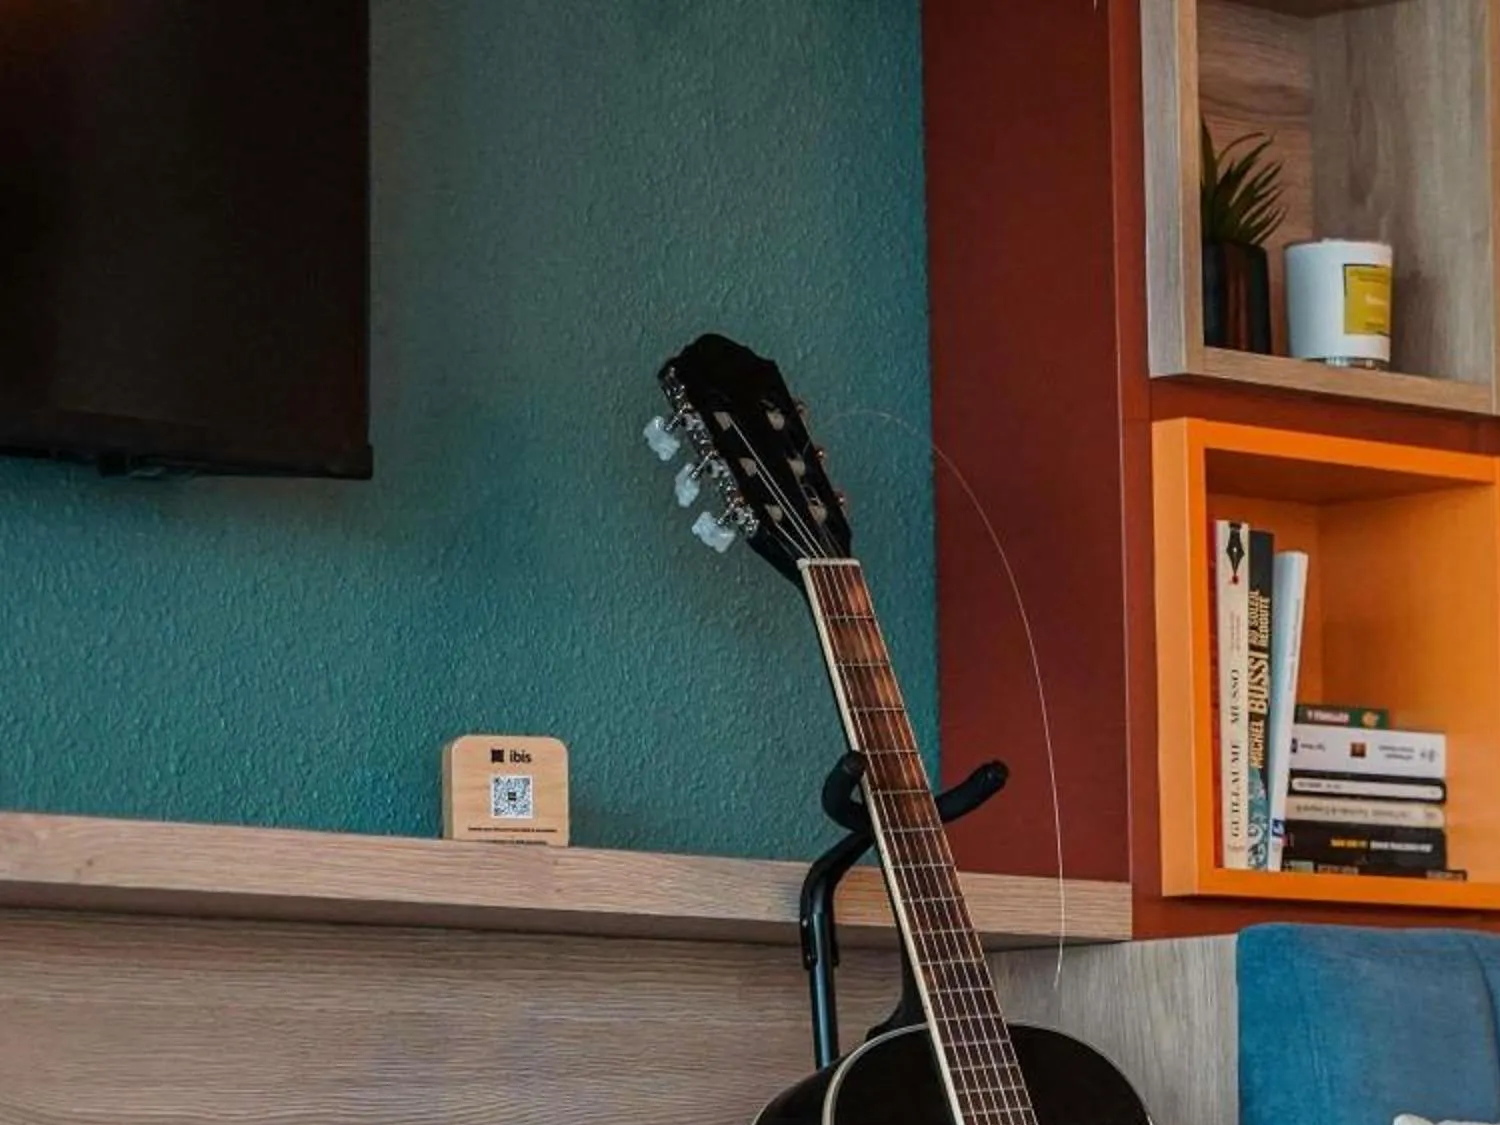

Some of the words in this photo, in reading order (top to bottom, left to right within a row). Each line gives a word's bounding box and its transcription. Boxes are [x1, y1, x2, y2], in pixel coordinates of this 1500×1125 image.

[1230, 668, 1240, 728] MUSSO
[1248, 651, 1269, 715] BUSSI
[510, 749, 533, 763] ibis
[1250, 719, 1265, 769] MICHEL
[1230, 745, 1241, 839] GUILLAUME
